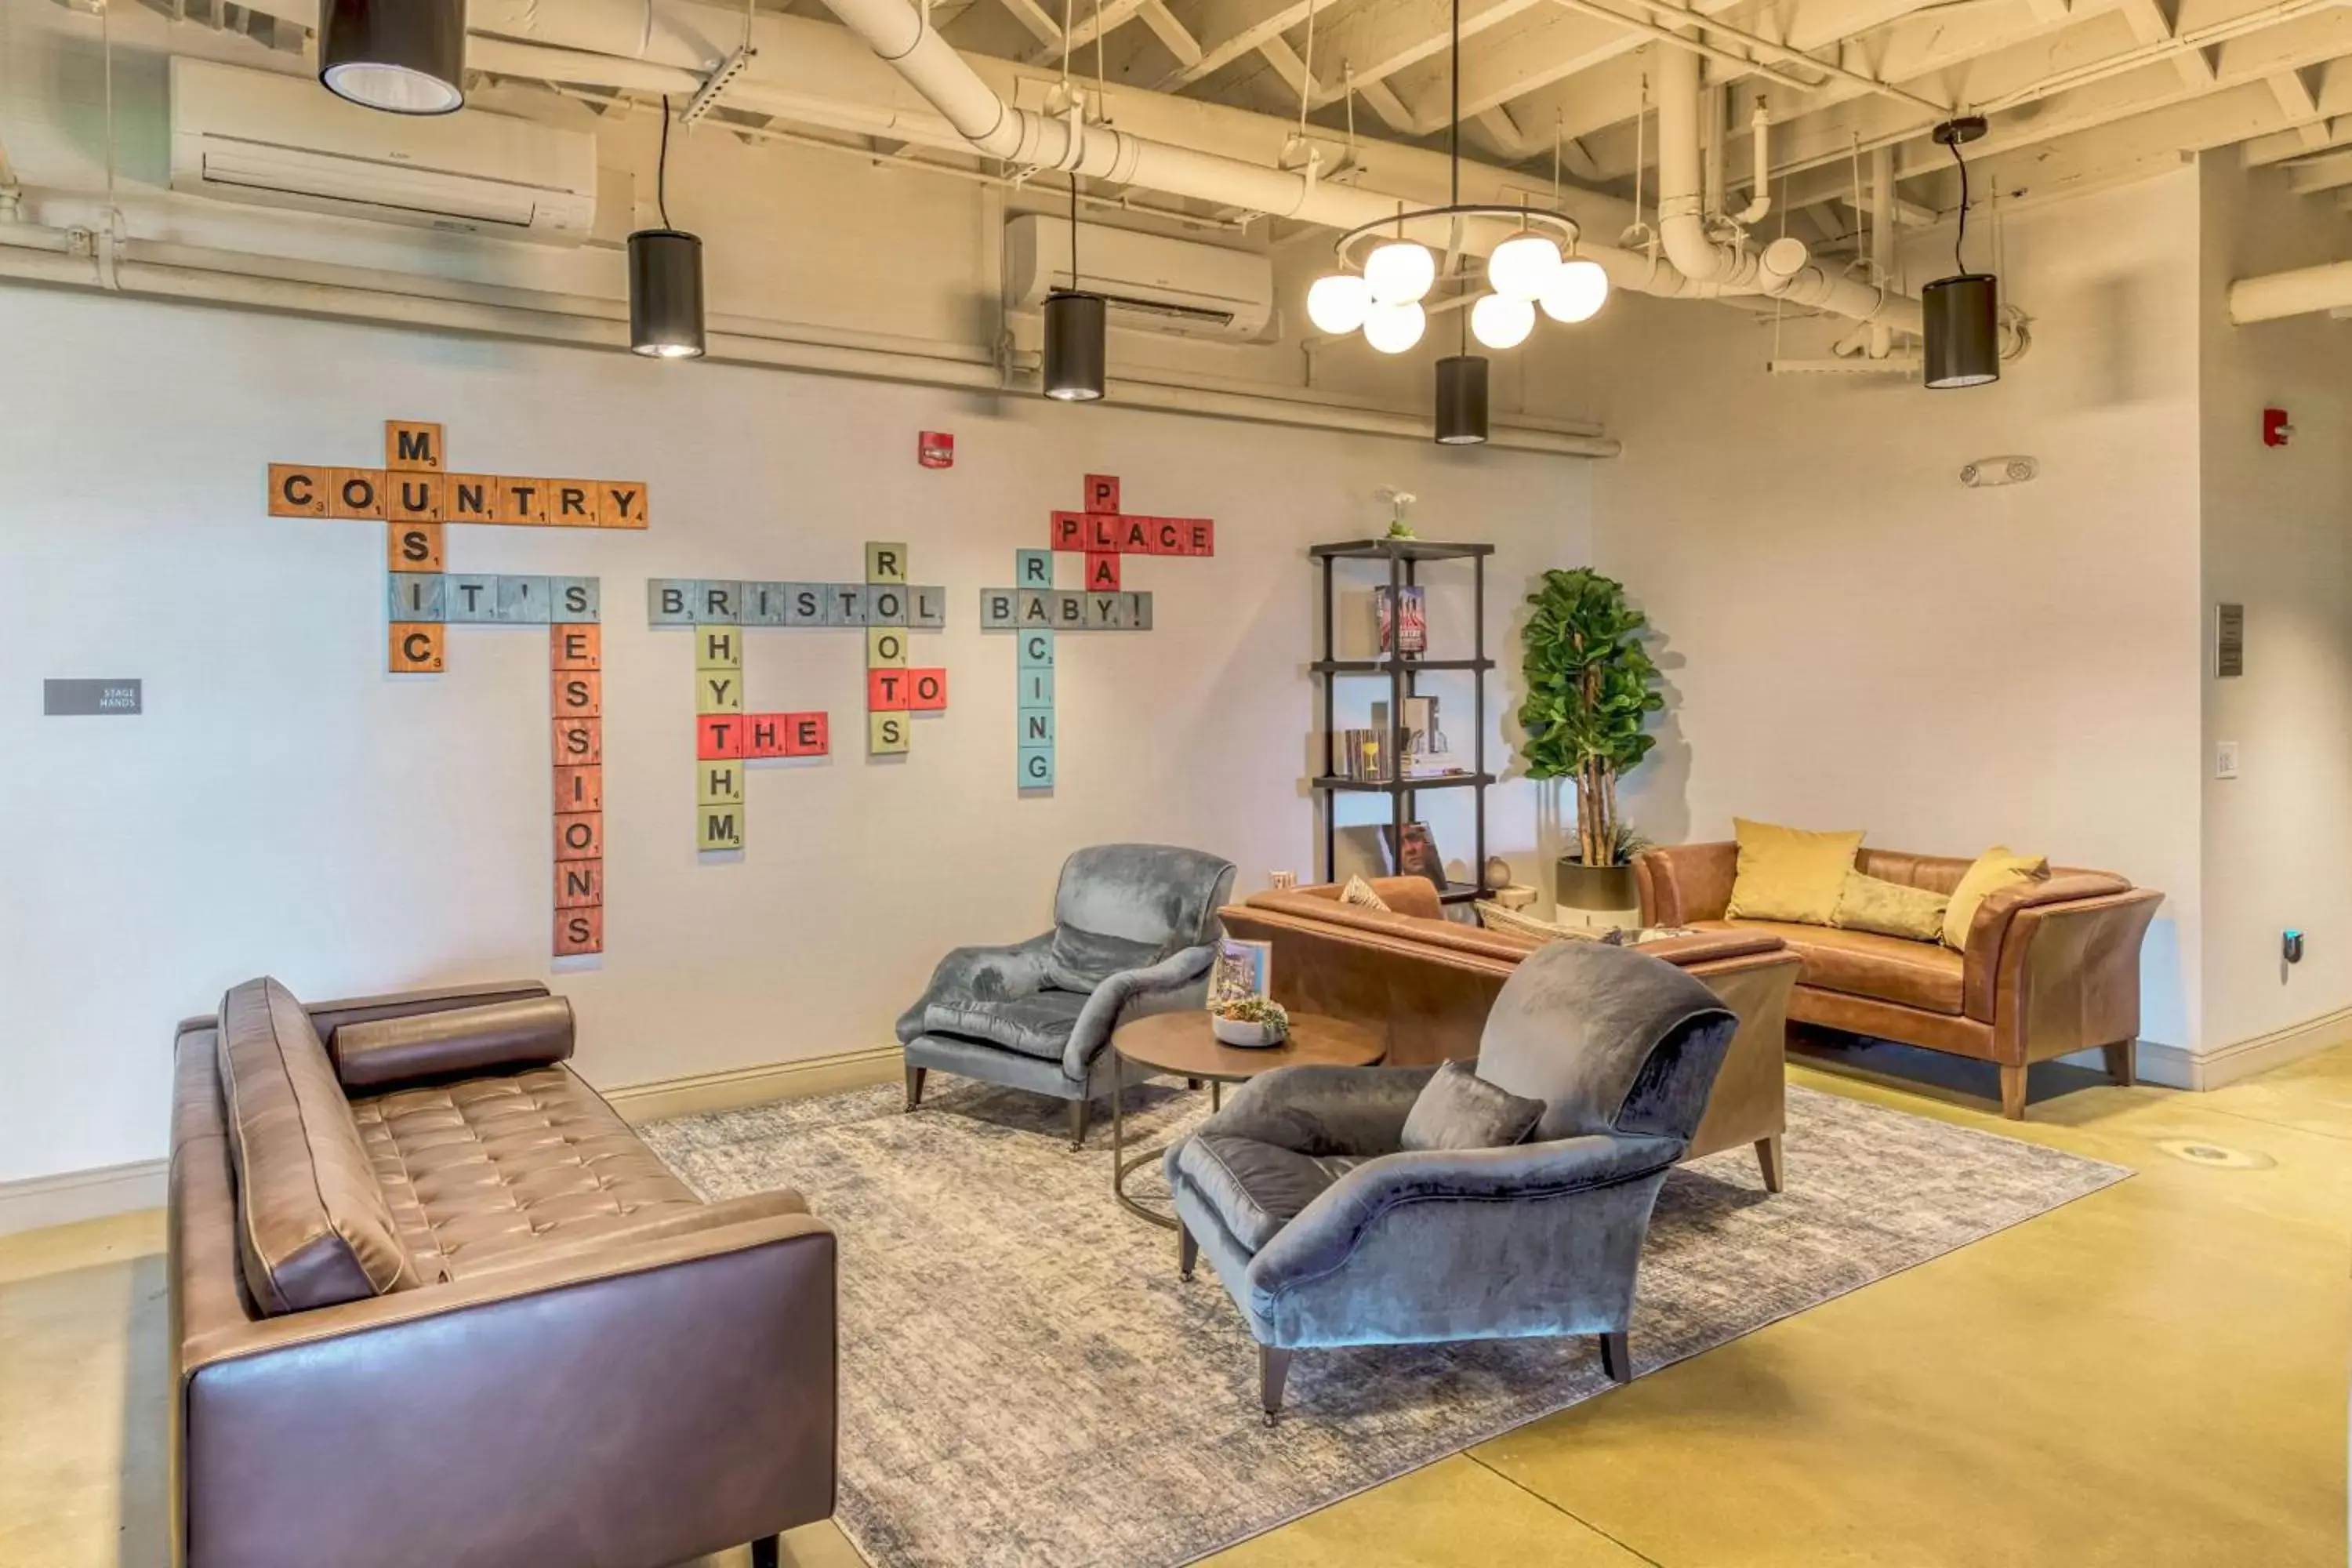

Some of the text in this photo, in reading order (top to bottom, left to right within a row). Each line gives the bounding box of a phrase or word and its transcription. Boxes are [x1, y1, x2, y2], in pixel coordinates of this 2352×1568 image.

[284, 474, 636, 517] COUNTRY
[398, 430, 430, 662] MUSIC
[1062, 521, 1207, 548] PLACE
[1095, 484, 1113, 620] PLAY
[413, 583, 587, 613] IT'S
[662, 589, 934, 618] BRISTOL
[993, 594, 1139, 626] BABY!
[878, 551, 900, 743] ROOTS
[1027, 558, 1047, 778] RACING
[100, 699, 135, 707] HANDS
[104, 688, 134, 697] STAGE
[880, 677, 938, 701] TO
[707, 590, 733, 840] RHYTHM
[710, 721, 817, 749] THE
[565, 586, 592, 943] SESSIONS
